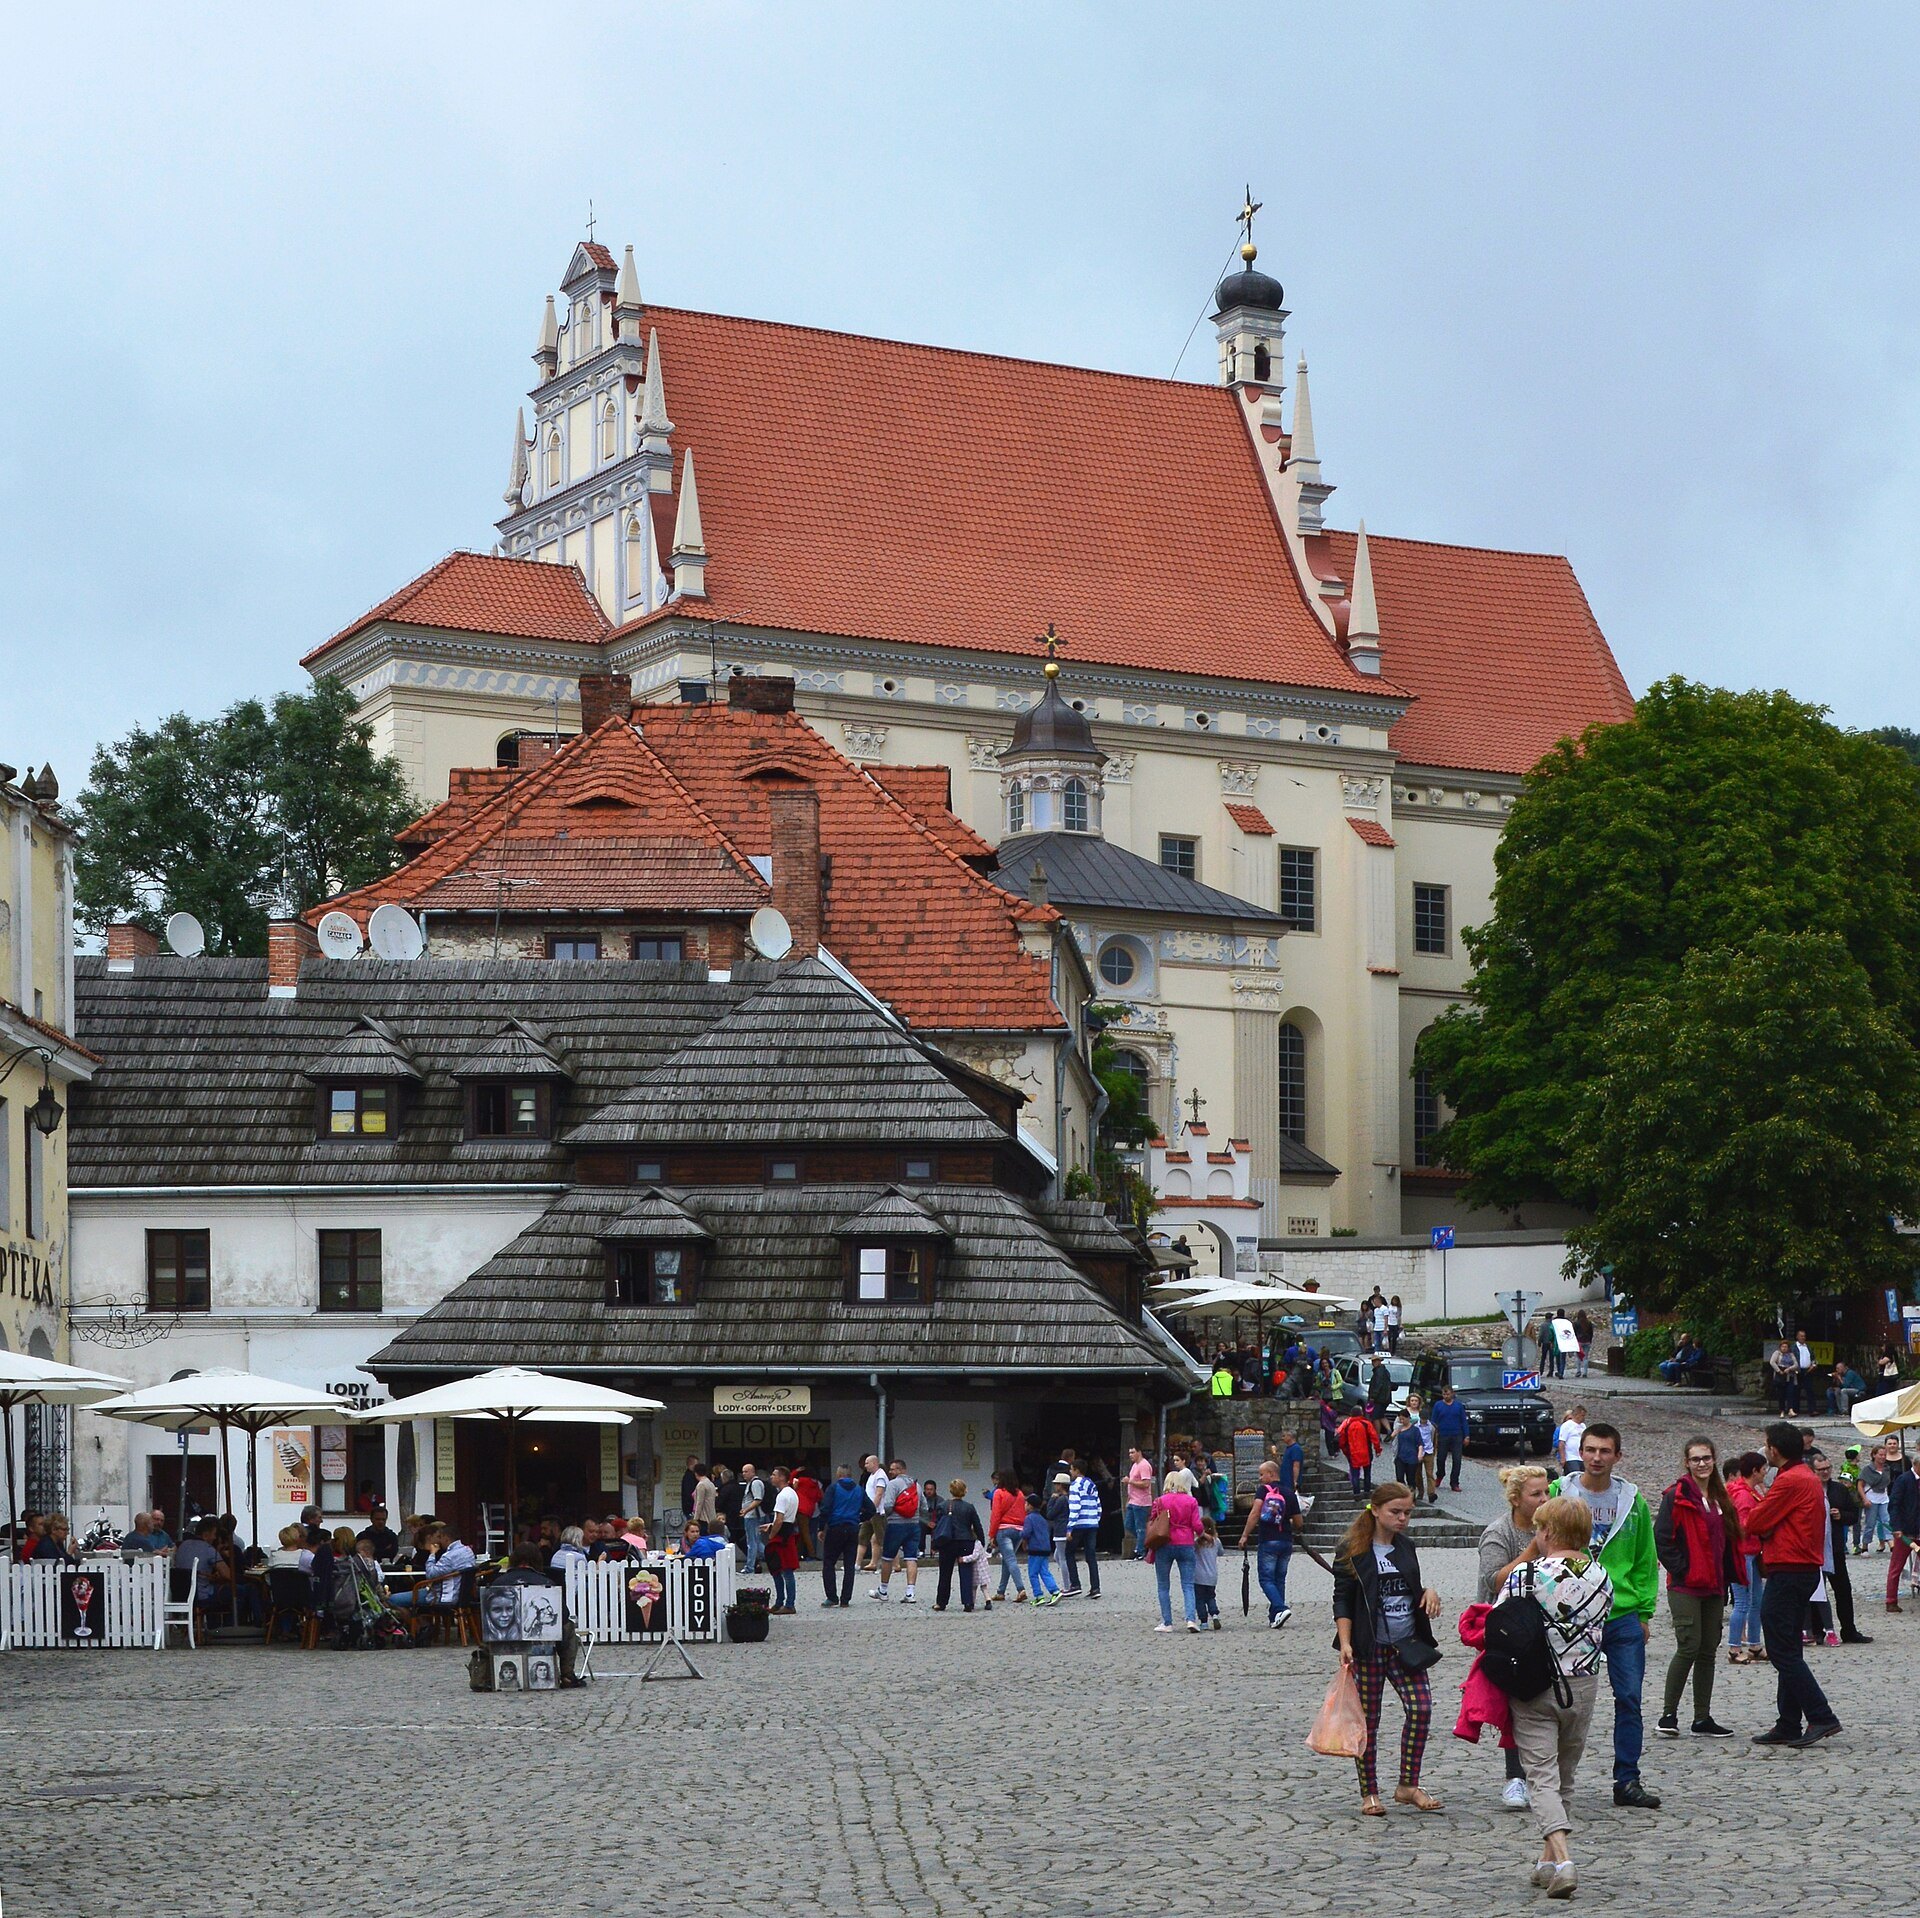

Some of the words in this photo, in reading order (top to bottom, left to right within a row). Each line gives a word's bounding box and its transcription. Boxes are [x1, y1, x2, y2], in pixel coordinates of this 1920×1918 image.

[1614, 1323, 1638, 1335] WC
[1504, 1373, 1539, 1389] TAXI
[325, 1383, 369, 1396] LODY
[718, 1404, 741, 1412] LODY
[745, 1404, 773, 1412] GOFRY
[776, 1404, 807, 1412] DESERY
[664, 1429, 700, 1441] LODY
[721, 1424, 822, 1445] LODY
[967, 1423, 976, 1460] LODY
[693, 1568, 705, 1628] LODY
